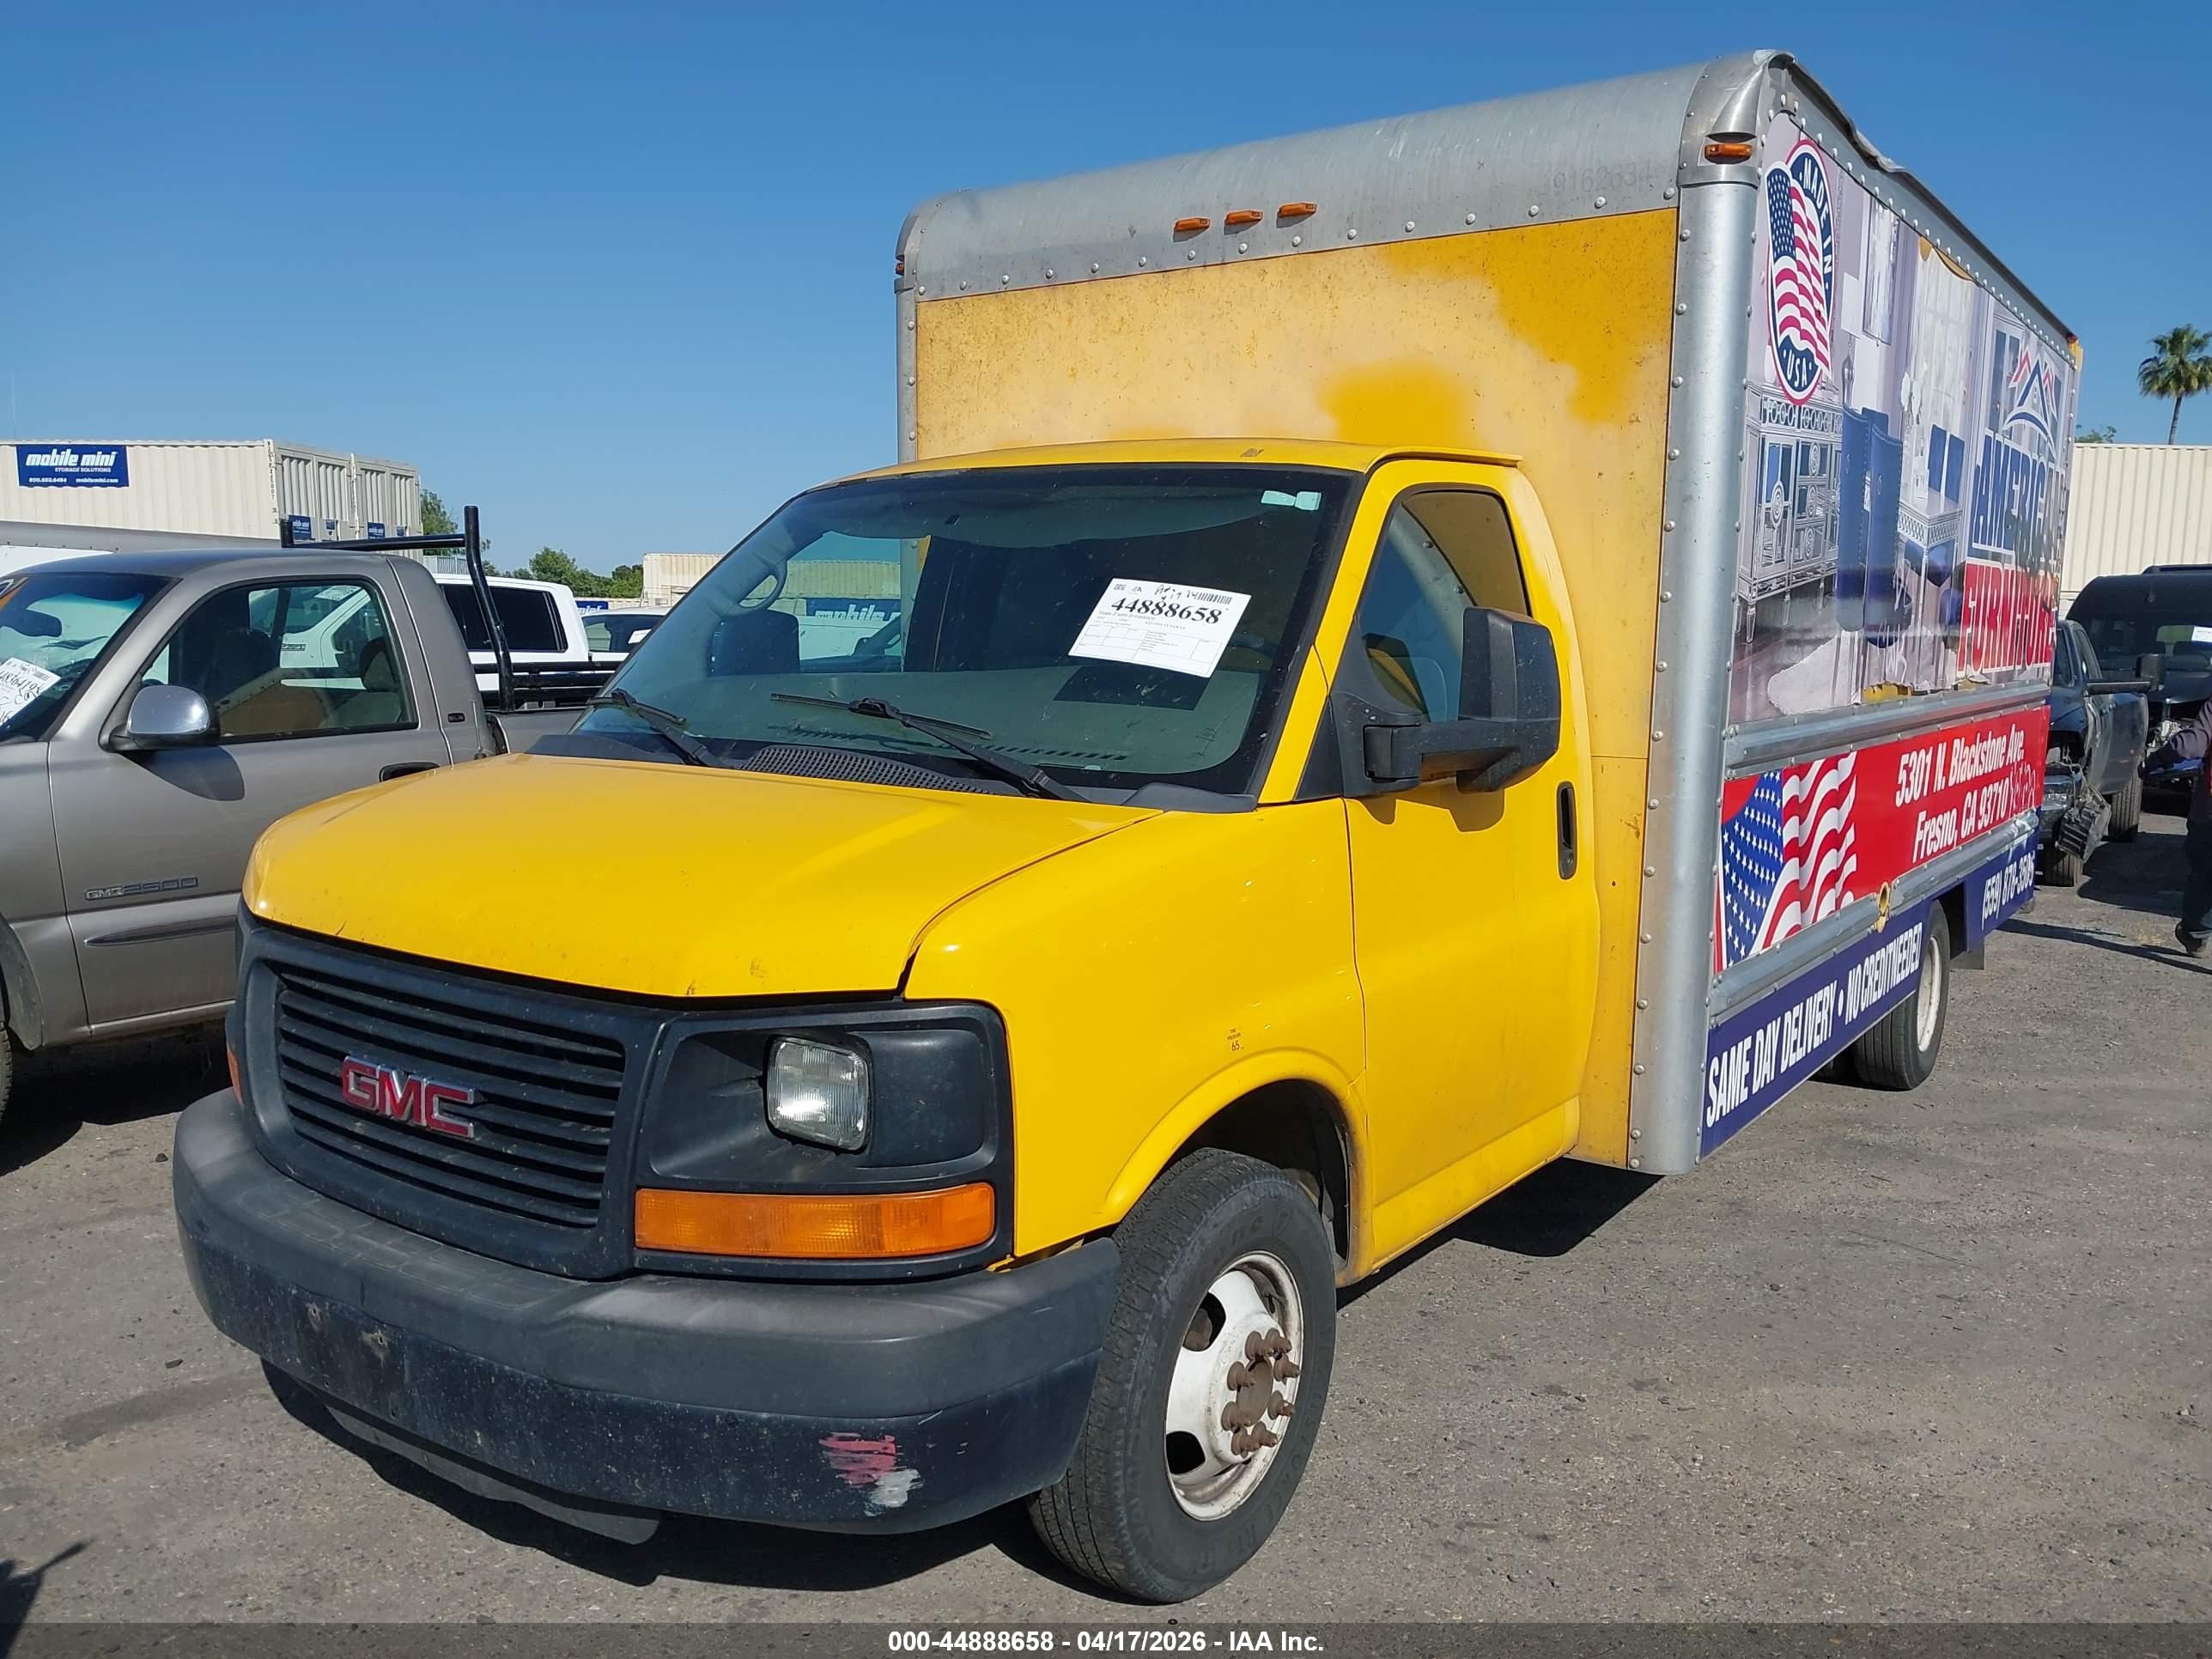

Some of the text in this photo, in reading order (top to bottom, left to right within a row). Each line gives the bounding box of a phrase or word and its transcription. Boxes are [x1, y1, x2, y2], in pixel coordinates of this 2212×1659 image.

[1802, 157, 1832, 275] MADE IN
[1786, 348, 1808, 388] USA
[26, 448, 118, 466] mobile mini
[1972, 428, 2066, 563] AMERICAN
[1111, 598, 1223, 624] 44888658
[1956, 558, 2058, 678] FURNITURE
[1895, 746, 1934, 808] 5301
[1933, 741, 1948, 793] N.
[1948, 730, 2007, 787] Blackstone
[2006, 723, 2025, 766] Ave.
[1911, 807, 1959, 864] Fresno,
[1960, 789, 1978, 839] CA
[1978, 776, 2010, 831] 93710
[1982, 868, 2002, 932] (559)
[1706, 1035, 1753, 1127] SAME
[1752, 1016, 1782, 1095] DAY
[1780, 980, 1838, 1073] DELIVERY
[1845, 963, 1862, 1025] NO
[343, 1055, 475, 1139] GMC
